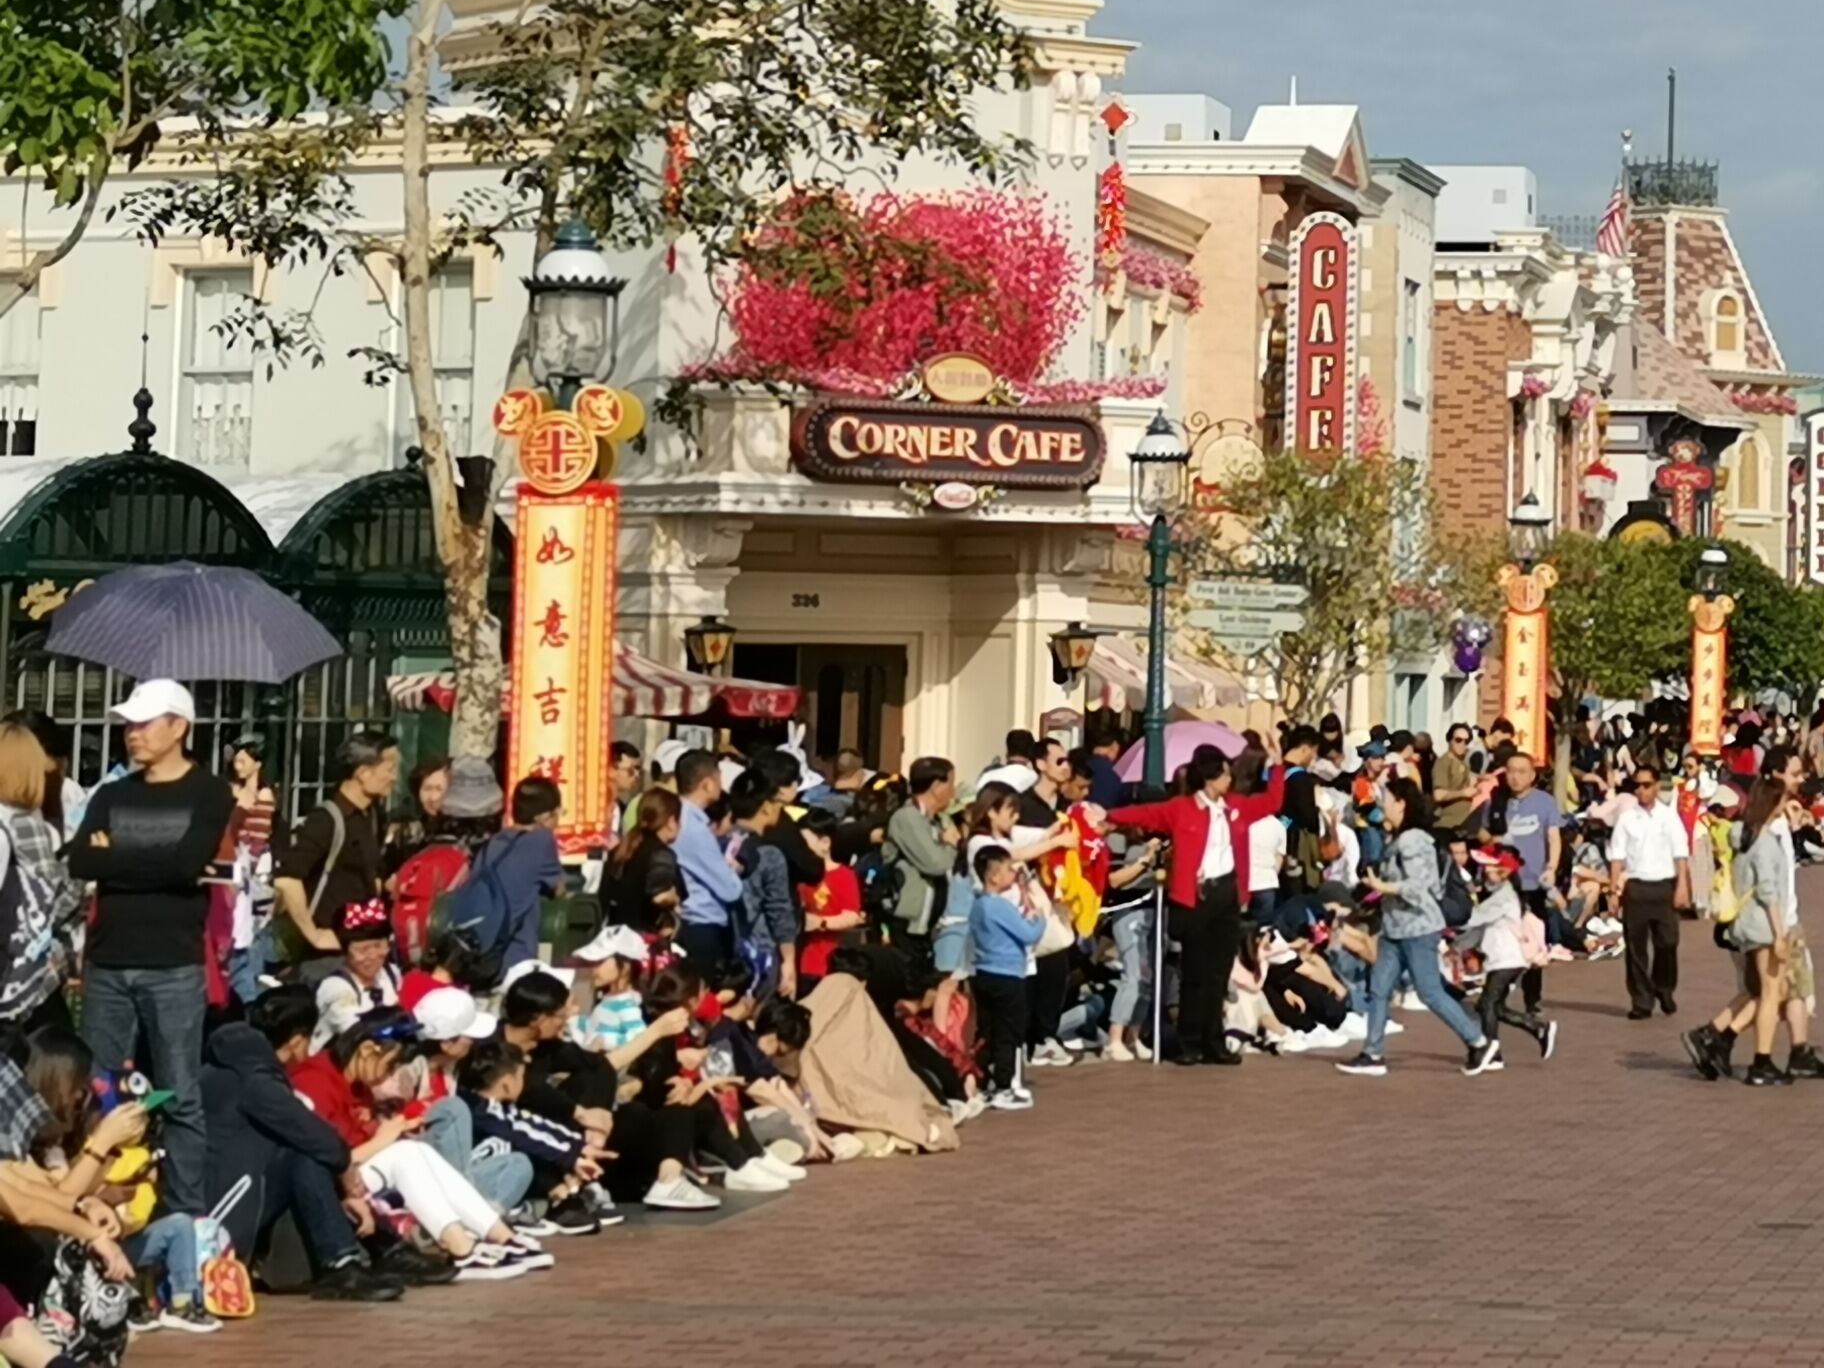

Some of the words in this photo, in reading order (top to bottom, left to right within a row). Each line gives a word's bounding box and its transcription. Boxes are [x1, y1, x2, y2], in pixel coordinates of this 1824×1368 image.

[1308, 248, 1336, 451] CAFE
[828, 415, 992, 466] CORNER
[988, 423, 1086, 467] CAFE
